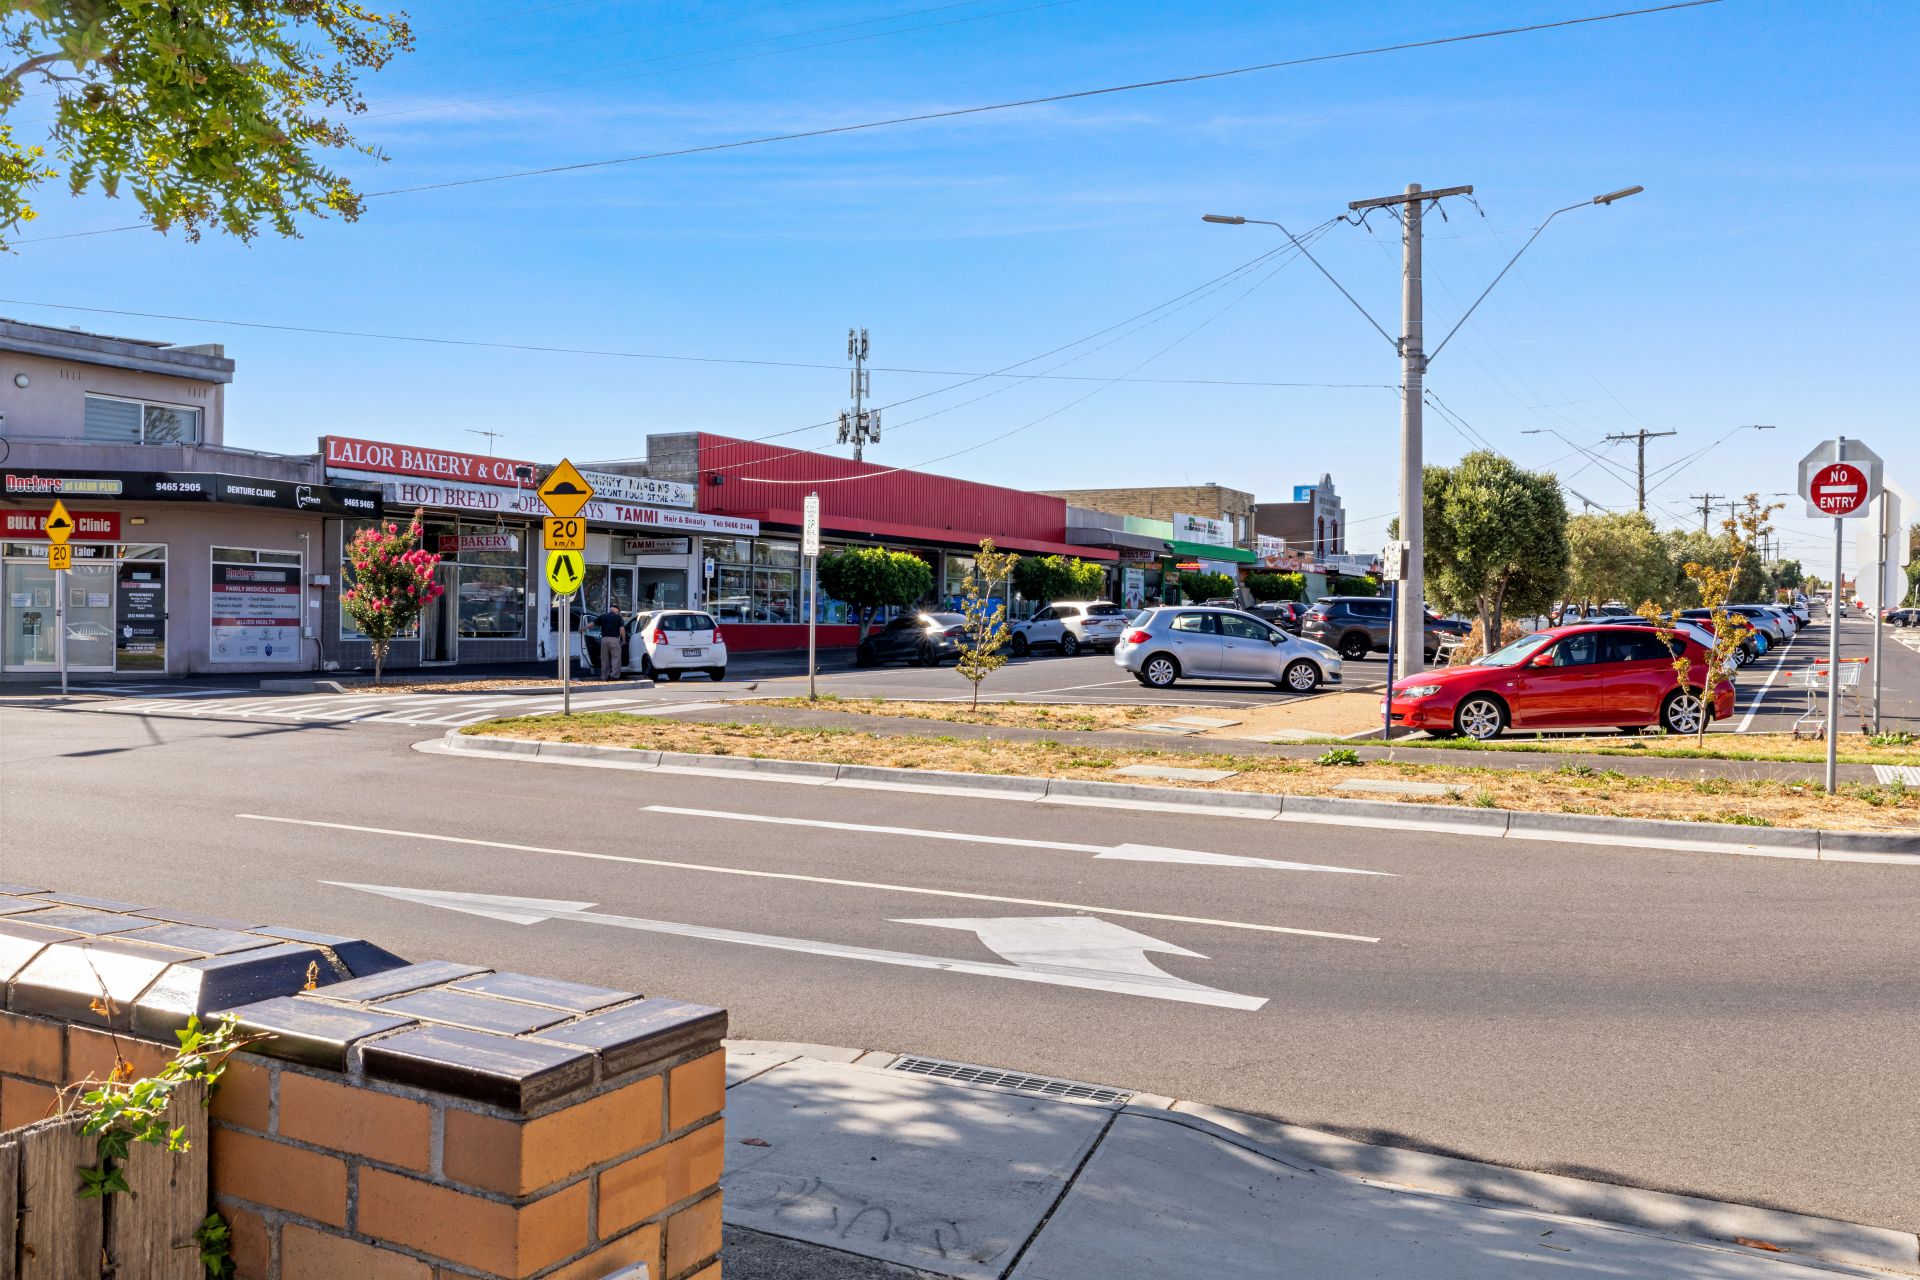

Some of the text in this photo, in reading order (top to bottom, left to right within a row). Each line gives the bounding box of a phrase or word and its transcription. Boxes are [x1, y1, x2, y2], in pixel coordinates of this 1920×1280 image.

[328, 440, 396, 468] LALOR
[400, 449, 473, 477] BAKERY
[477, 463, 488, 479] &
[1830, 470, 1848, 482] NO
[5, 475, 62, 493] Doctors
[155, 482, 201, 492] 9465 2905
[227, 485, 276, 498] DENTURE CLINIC
[344, 498, 375, 509] 9465 9465
[401, 482, 604, 519] HOT BREAD OPE AYS
[1820, 496, 1857, 508] ENTRY
[7, 516, 36, 530] BULK
[79, 518, 111, 532] Clinic
[615, 506, 659, 524] TAMMI
[664, 514, 678, 523] Hair
[679, 516, 684, 524] &
[685, 516, 707, 527] Beauty
[724, 521, 738, 529] 9466
[740, 523, 753, 531] 2144
[552, 520, 578, 538] 20
[461, 535, 509, 547] BAKERY
[554, 540, 576, 548] km/h
[626, 540, 655, 549] TAMMI
[53, 546, 67, 561] 20
[74, 545, 96, 557] Lalor
